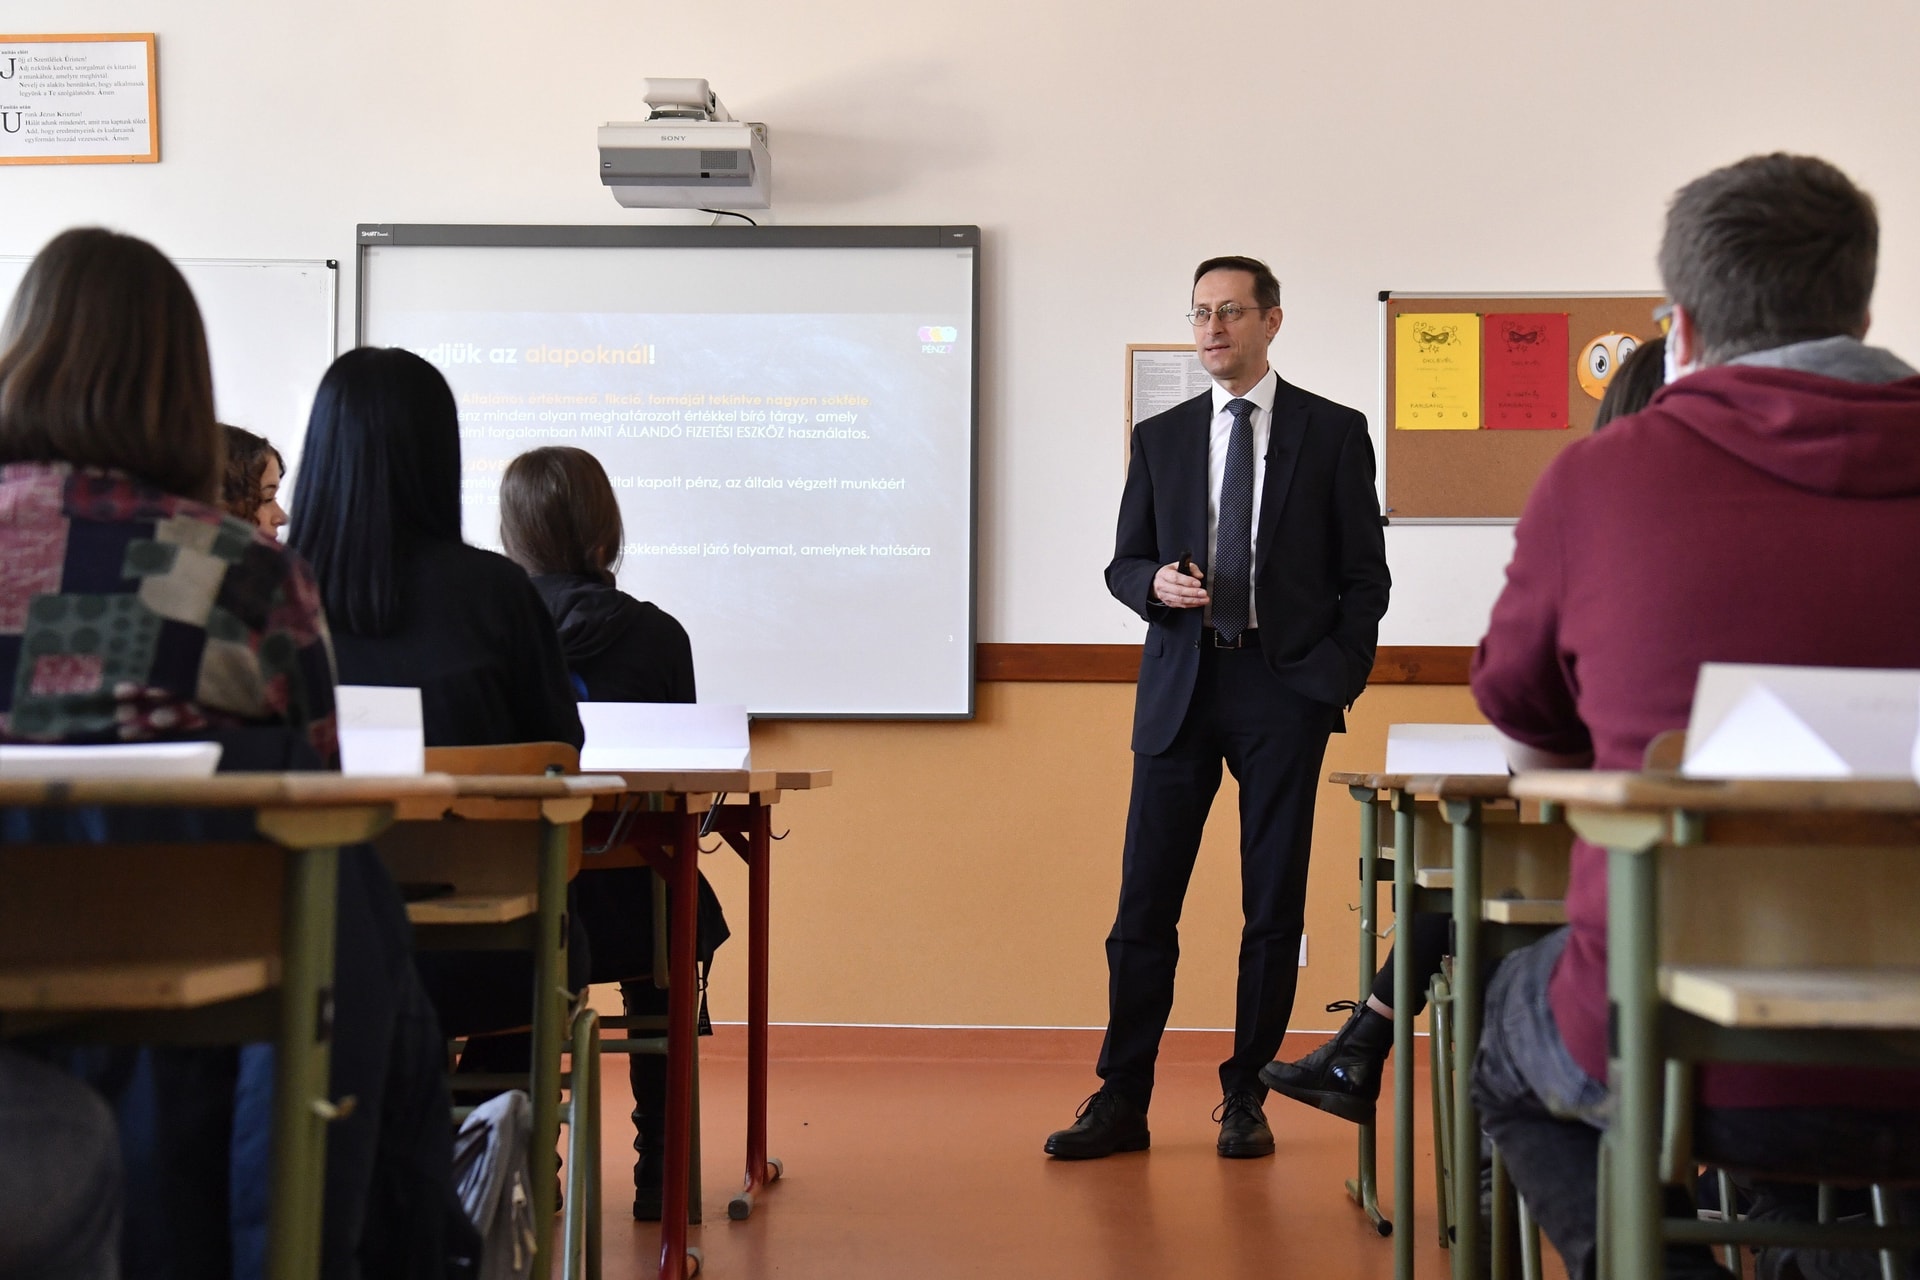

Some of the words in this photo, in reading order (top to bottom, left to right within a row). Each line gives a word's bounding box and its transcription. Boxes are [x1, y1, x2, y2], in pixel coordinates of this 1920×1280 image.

[488, 347, 518, 363] az
[524, 343, 656, 368] alapoknál!
[648, 393, 705, 408] formáját
[709, 393, 762, 406] tekintve
[766, 395, 818, 408] nagyon
[483, 409, 536, 422] minden
[538, 409, 577, 425] olyan
[580, 409, 681, 424] meghatározott
[683, 409, 738, 423] értékkel
[740, 410, 767, 423] bíró
[770, 410, 809, 425] tárgy,
[815, 411, 859, 426] amely
[487, 426, 578, 441] forgalomban
[580, 426, 614, 438] MINT
[616, 423, 683, 439] ÁLLANDÓ
[685, 424, 734, 438] FIZETÉSI
[788, 427, 871, 440] használatos.
[636, 475, 682, 491] kapott
[685, 475, 722, 490] pénz,
[725, 479, 742, 489] az
[744, 475, 784, 489] általa
[786, 475, 838, 491] végzett
[840, 476, 906, 491] munkáért
[620, 543, 701, 556] sökkenéssel
[702, 543, 730, 558] járó
[732, 543, 798, 558] folyamat,
[800, 544, 868, 559] amelynek
[870, 544, 932, 557] hatására
[947, 634, 954, 643] 3
